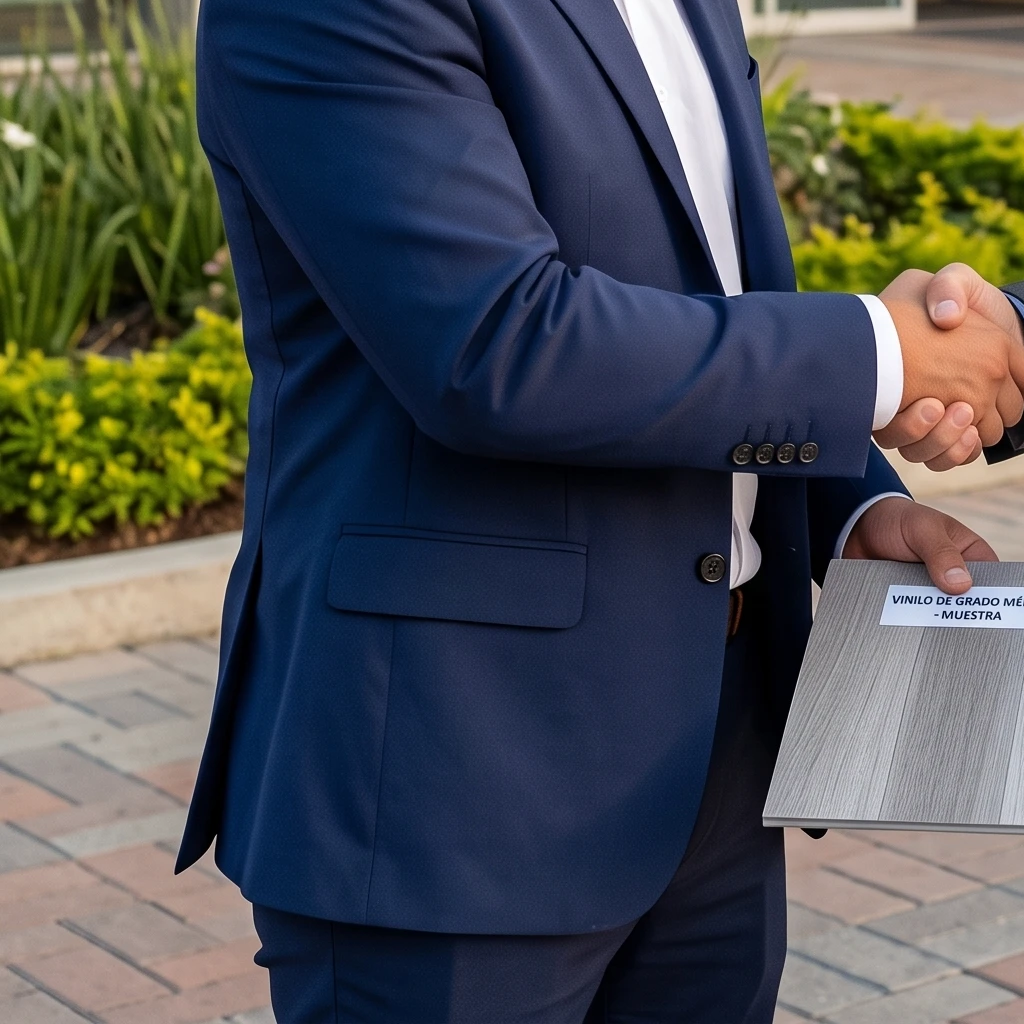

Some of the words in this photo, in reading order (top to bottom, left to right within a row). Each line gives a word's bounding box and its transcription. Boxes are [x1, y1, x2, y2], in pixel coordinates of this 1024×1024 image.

[892, 595, 934, 605] VINILO
[935, 596, 953, 606] DE
[955, 596, 1000, 607] GRADO
[941, 610, 1002, 621] MUESTRA
